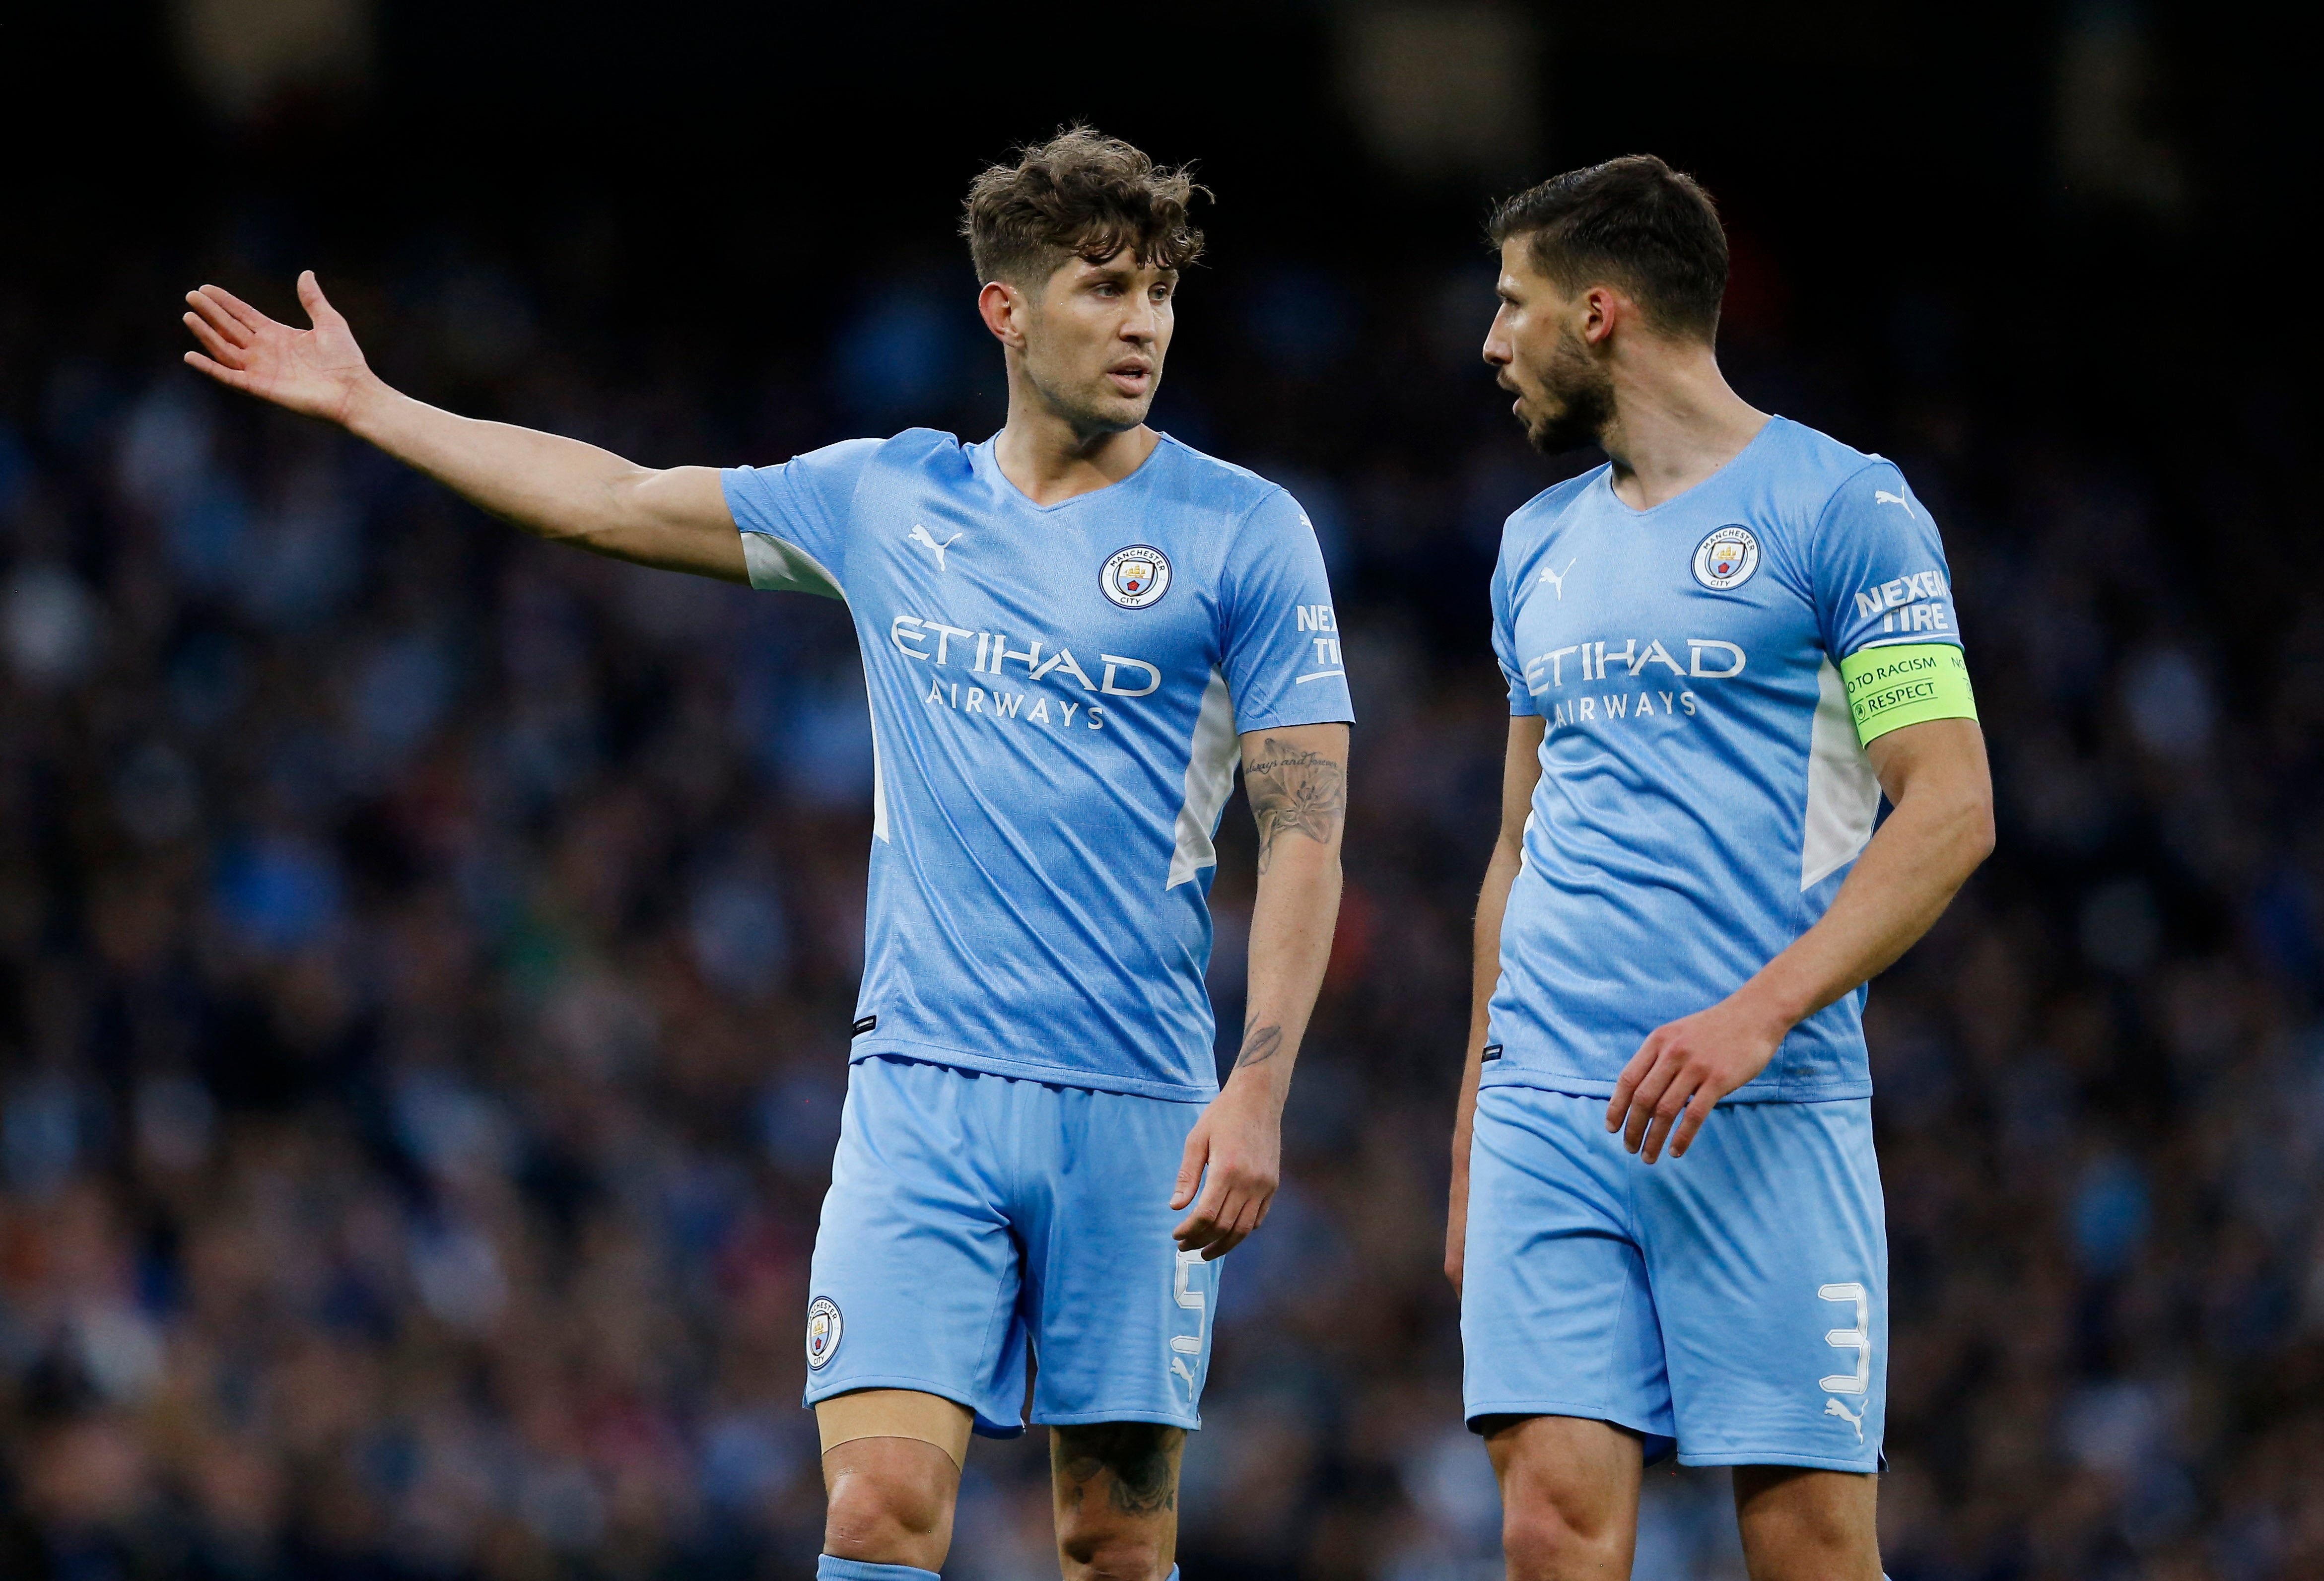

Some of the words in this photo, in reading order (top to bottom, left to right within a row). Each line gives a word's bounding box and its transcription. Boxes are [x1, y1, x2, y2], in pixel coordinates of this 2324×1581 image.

[1703, 529, 1755, 551] MANCHESTER
[1110, 550, 1165, 571] MANCHESTER
[1855, 570, 1947, 618] NEXEN
[1883, 603, 1949, 632] TIRE
[891, 616, 1162, 697] ETIHAD
[1525, 638, 1746, 696] ETIHAD
[1855, 673, 1873, 688] TO
[1877, 657, 1937, 680] RACISM
[925, 680, 1103, 730] AIRWAYS
[1556, 691, 1695, 729] AIRWAYS
[1868, 682, 1934, 712] RESPECT
[1170, 1246, 1206, 1355] 5
[1817, 1282, 1870, 1395] 3
[814, 1355, 824, 1365] CITY
